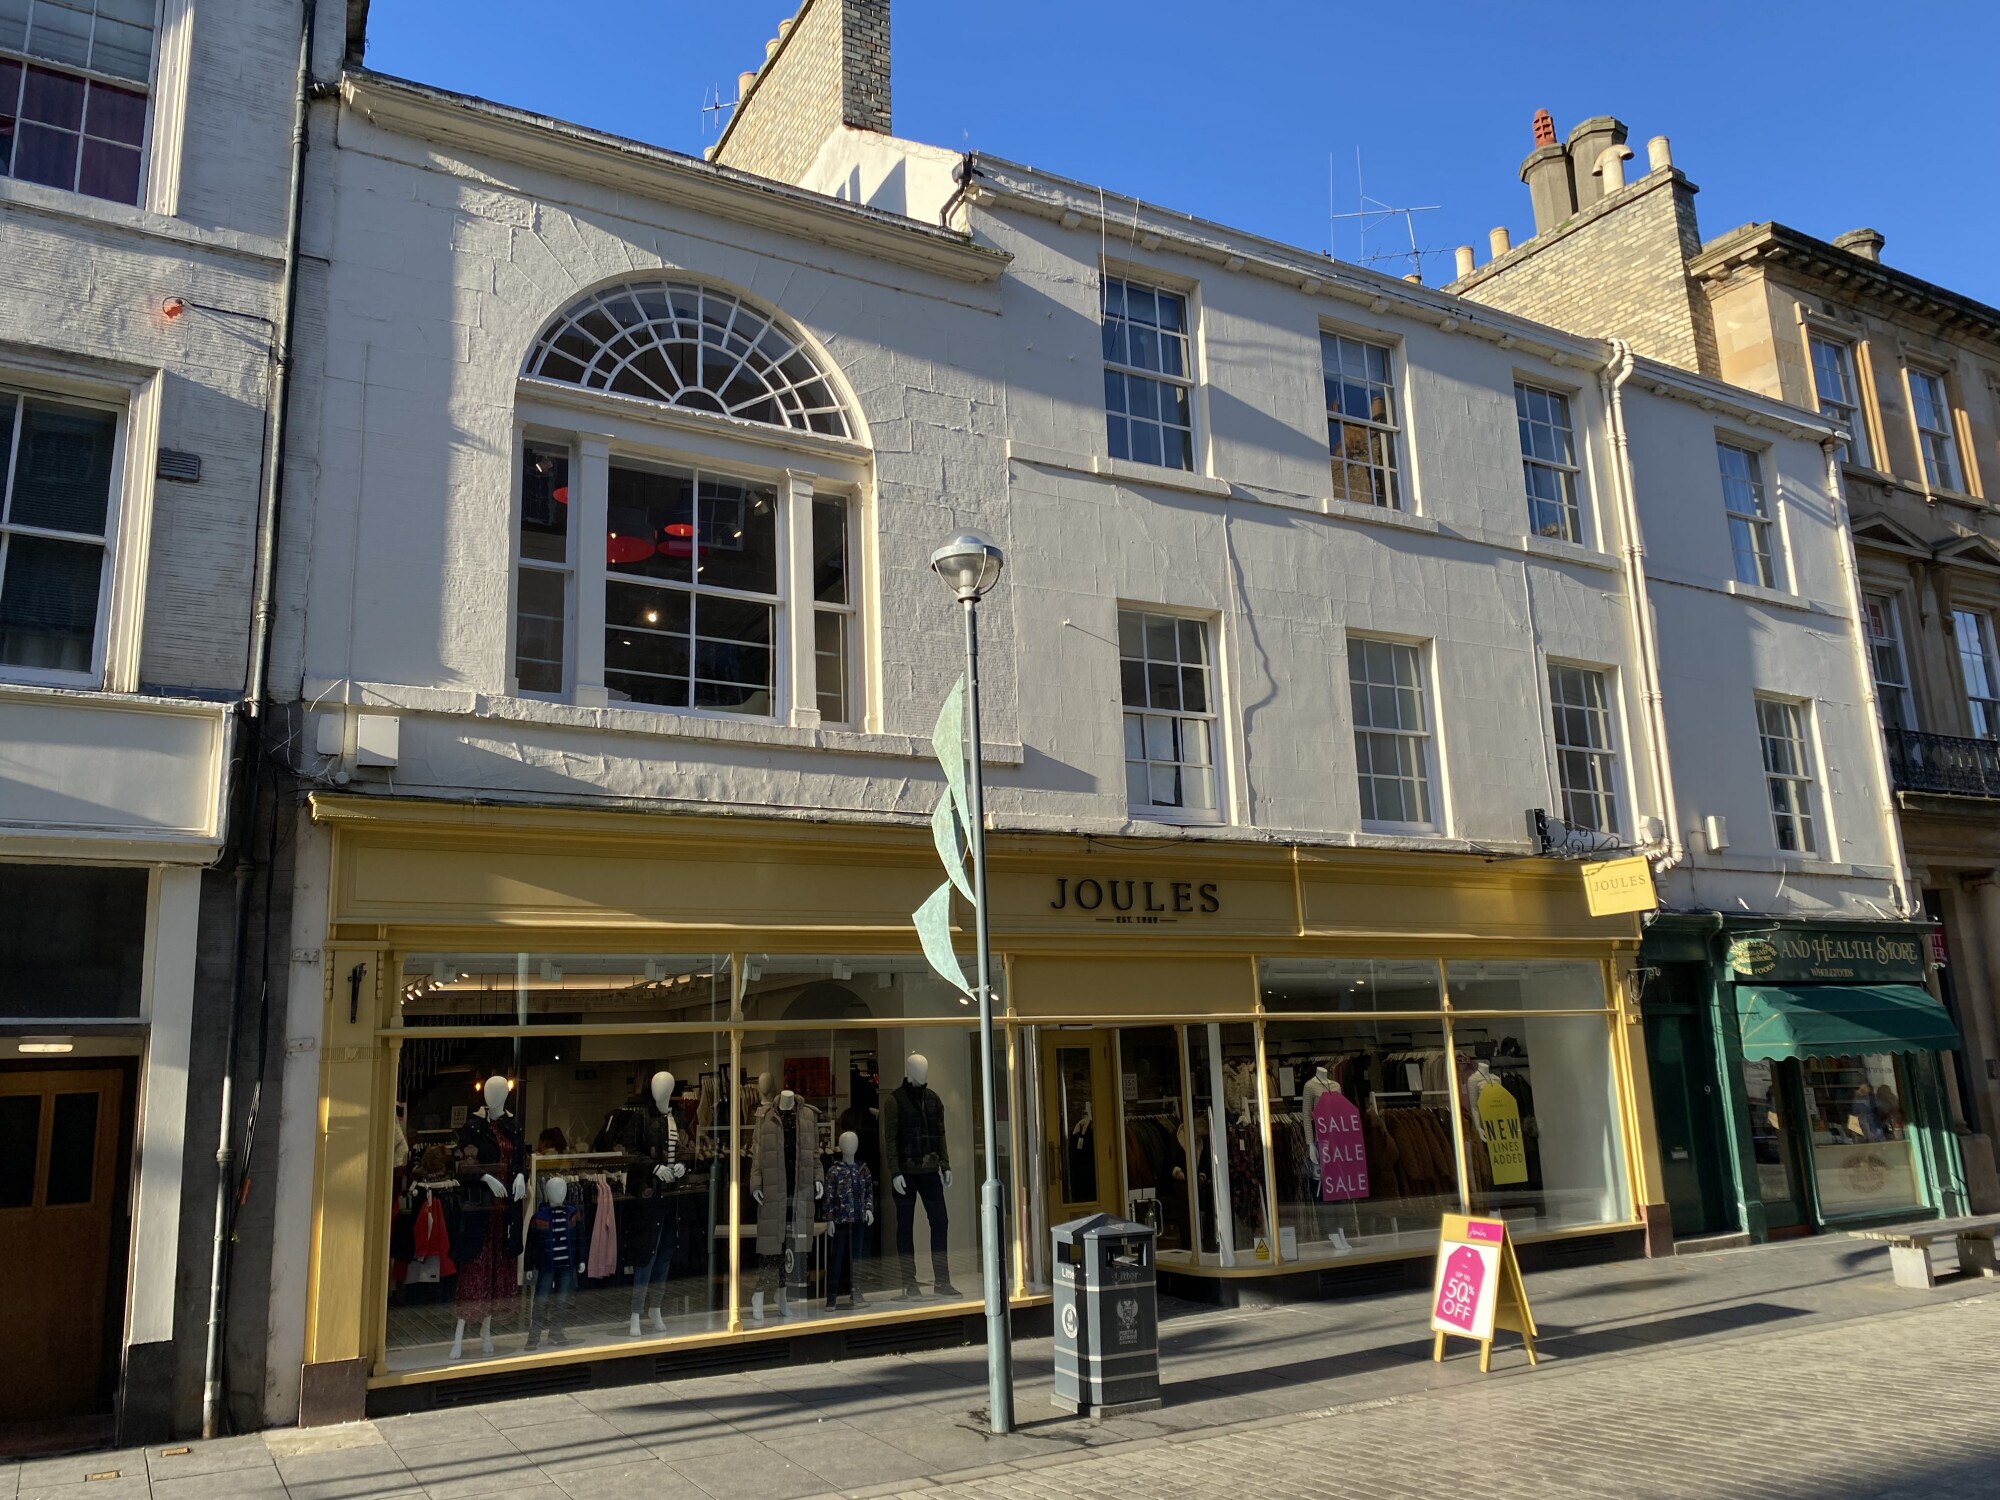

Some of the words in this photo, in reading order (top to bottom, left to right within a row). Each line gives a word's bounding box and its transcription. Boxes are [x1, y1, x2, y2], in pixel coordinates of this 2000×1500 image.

[1594, 874, 1646, 892] JOULES
[1051, 878, 1220, 913] JOULES
[1811, 934, 1874, 966] HEALTH
[1876, 935, 1918, 965] STORE
[1810, 967, 1854, 978] WHOLEFOODS
[1704, 1085, 1711, 1095] 9
[1317, 1115, 1360, 1134] SALE
[1485, 1118, 1519, 1141] NEW
[1322, 1144, 1364, 1164] SALE
[1493, 1142, 1520, 1154] LINES
[1493, 1153, 1523, 1166] ADDED
[1325, 1174, 1367, 1194] SALE
[1442, 1298, 1472, 1321] OFF
